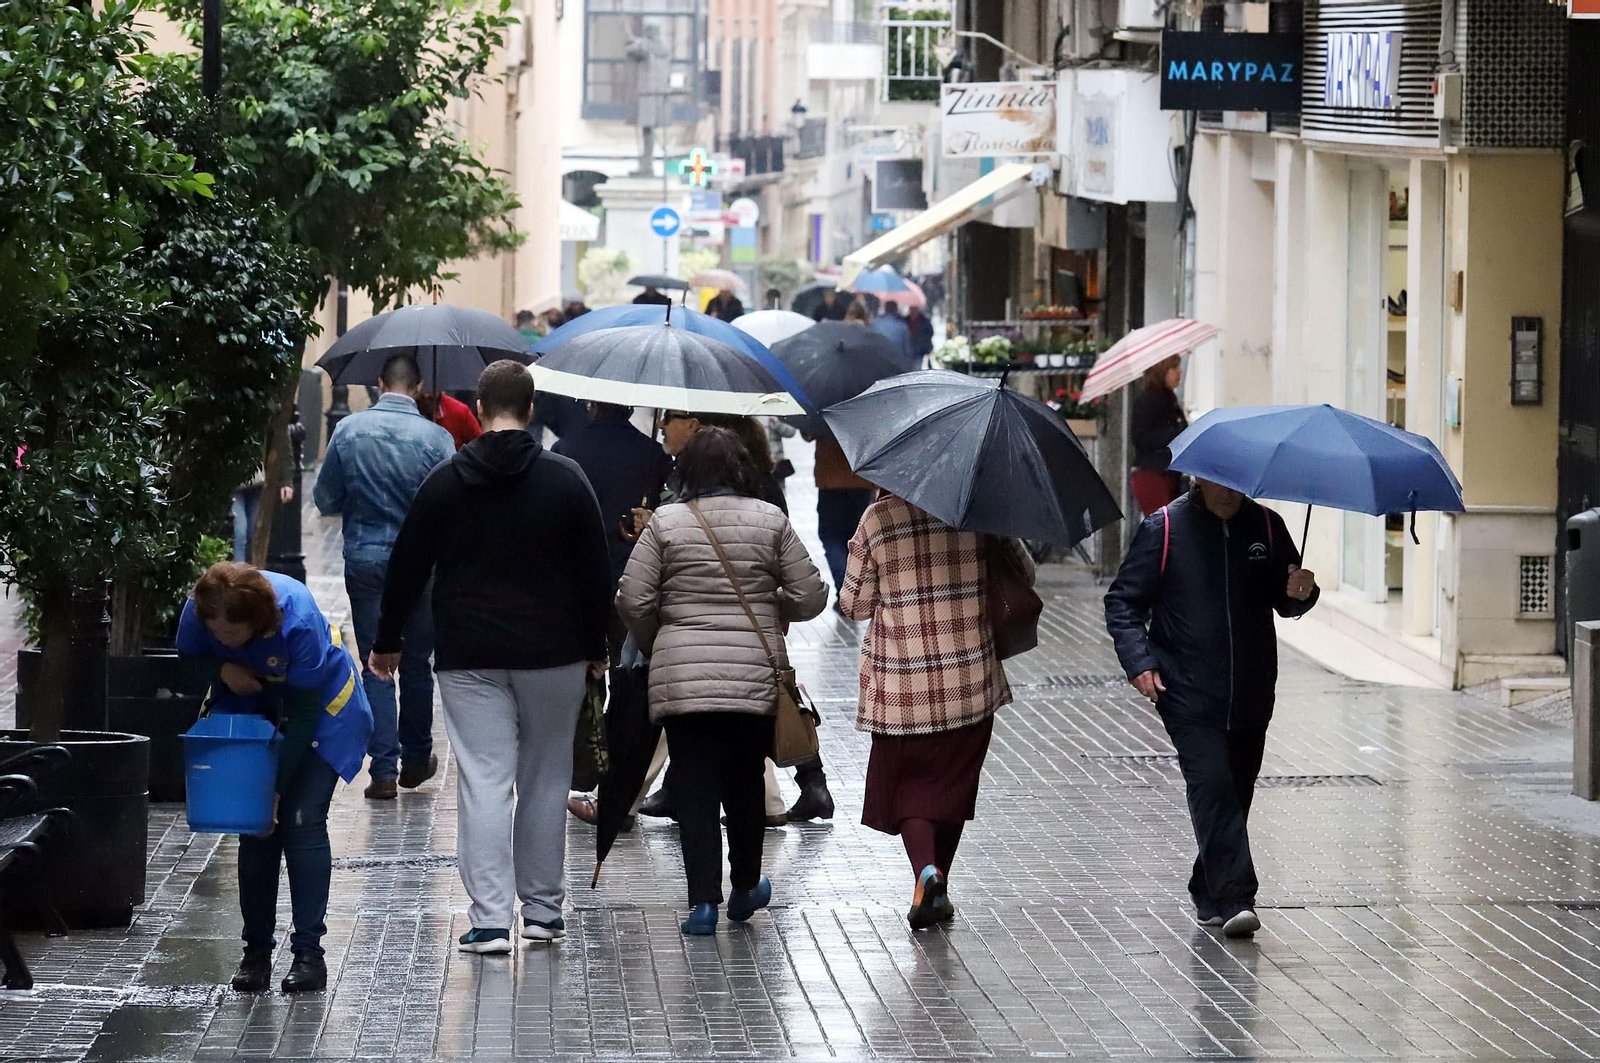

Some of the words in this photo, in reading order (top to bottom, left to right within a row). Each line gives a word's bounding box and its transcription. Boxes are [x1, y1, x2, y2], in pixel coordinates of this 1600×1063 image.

[1168, 60, 1294, 82] MARYPAZ
[1325, 32, 1392, 107] MARYPAZ
[946, 86, 1048, 115] Zinnia
